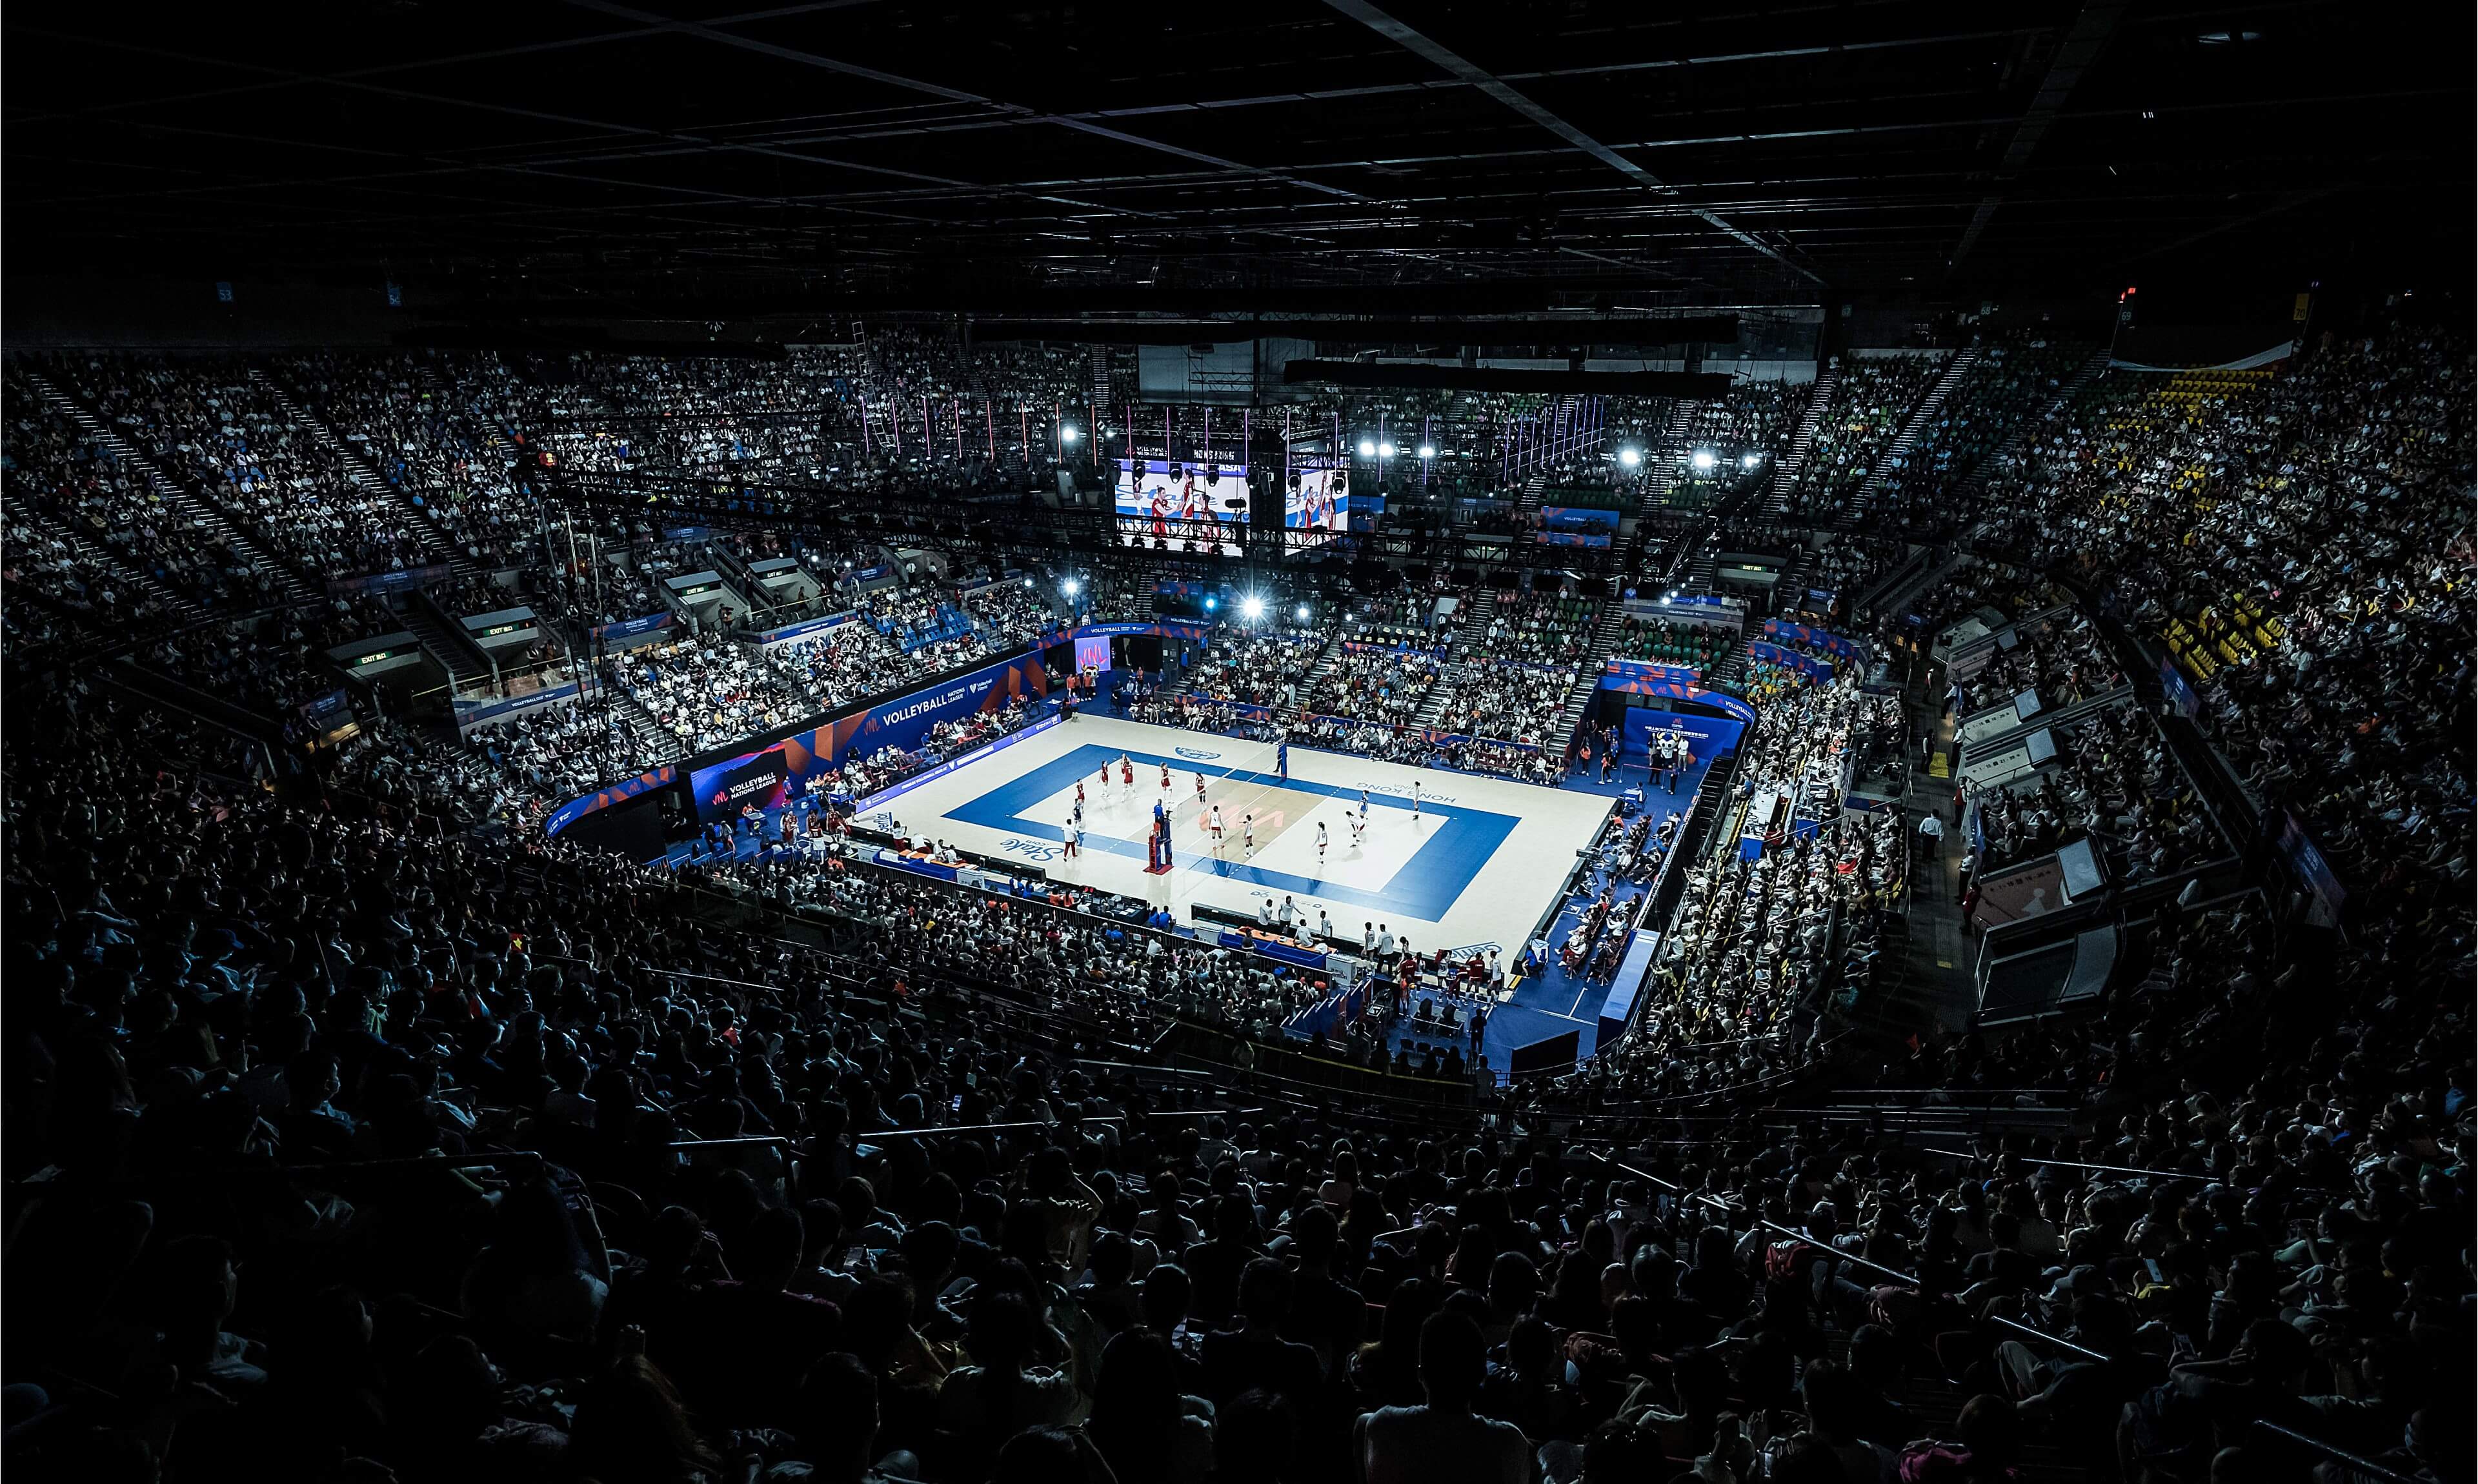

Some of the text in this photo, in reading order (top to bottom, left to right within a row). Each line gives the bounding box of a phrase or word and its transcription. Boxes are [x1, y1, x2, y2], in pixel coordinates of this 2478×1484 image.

[219, 289, 232, 300] 53
[2122, 311, 2131, 321] 69
[2295, 308, 2306, 319] 70
[361, 655, 375, 664] EXIT
[947, 687, 965, 697] NATIONS
[511, 697, 536, 707] VOLLEYBALL
[948, 694, 963, 703] LEAGUE
[883, 694, 947, 727] VOLLEYBALL
[1725, 700, 1749, 716] VOLLEYBALL
[712, 772, 776, 806] VNL VOLLEYBALL
[730, 778, 776, 800] NATIONS LEAGUE
[1356, 782, 1456, 803] HONG KONG
[1000, 838, 1064, 861] Stake
